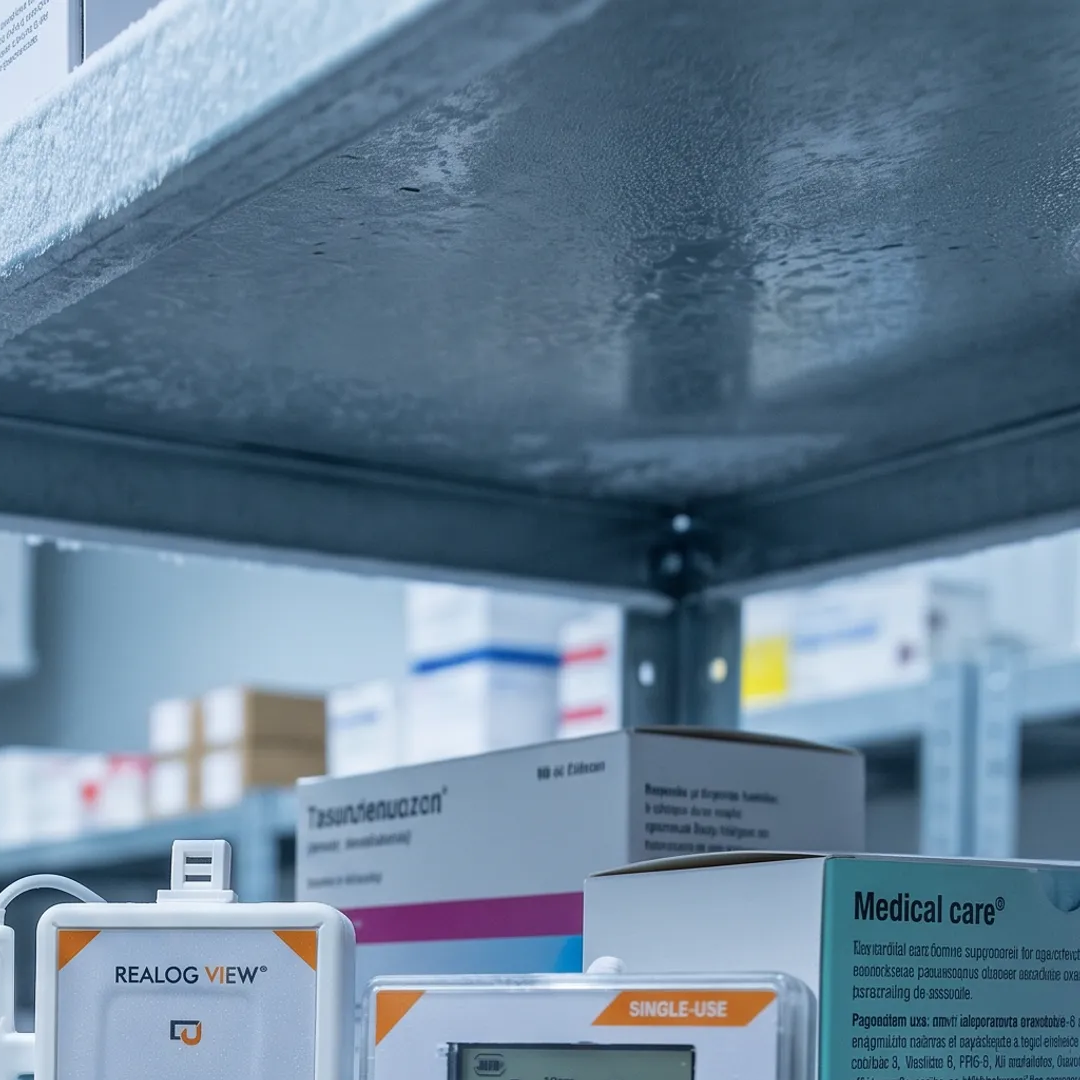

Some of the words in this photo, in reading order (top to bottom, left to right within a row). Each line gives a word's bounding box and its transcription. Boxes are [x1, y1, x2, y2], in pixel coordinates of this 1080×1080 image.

[854, 891, 943, 923] Medical
[115, 966, 199, 984] REALOG
[629, 1000, 727, 1018] SINGLE-USE
